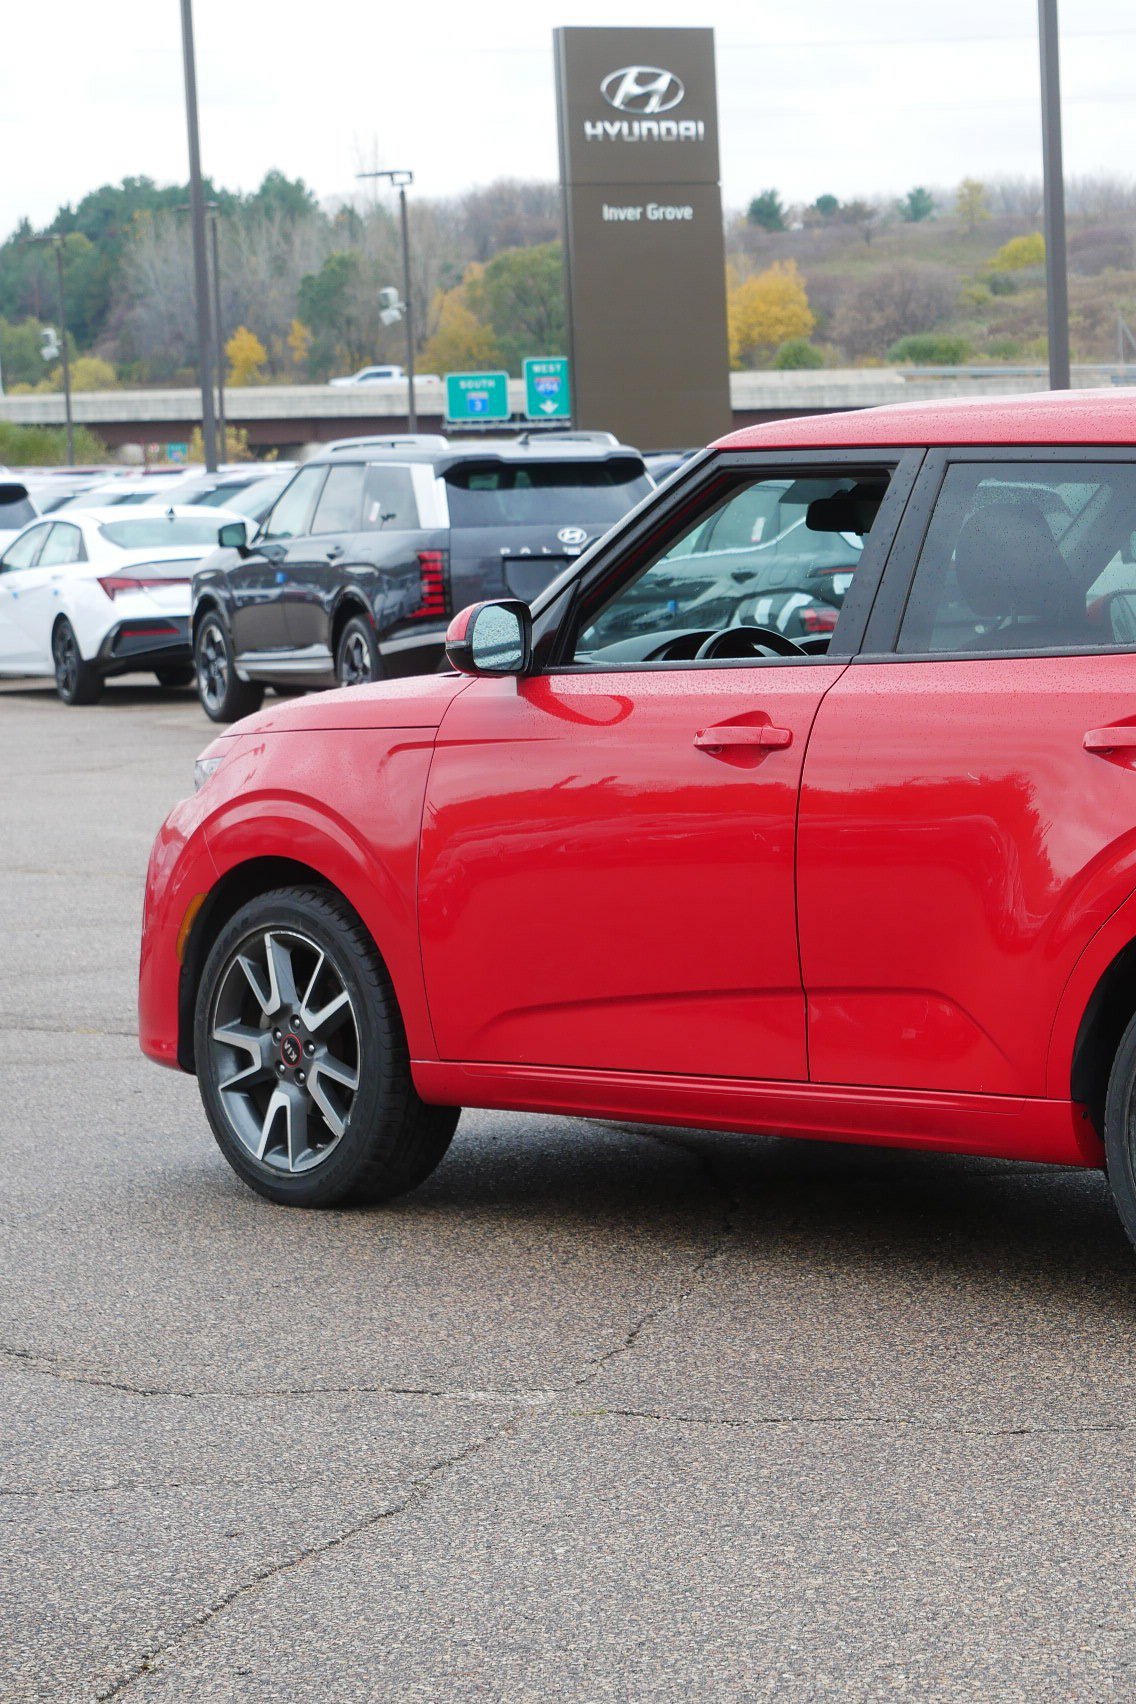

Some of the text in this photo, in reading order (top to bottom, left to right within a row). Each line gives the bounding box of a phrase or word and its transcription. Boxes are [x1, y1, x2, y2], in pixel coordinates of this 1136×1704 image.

[584, 120, 705, 141] HYUNDAI
[602, 203, 693, 221] Inver Grove
[532, 363, 561, 374] WEST
[459, 379, 495, 390] SOUTH
